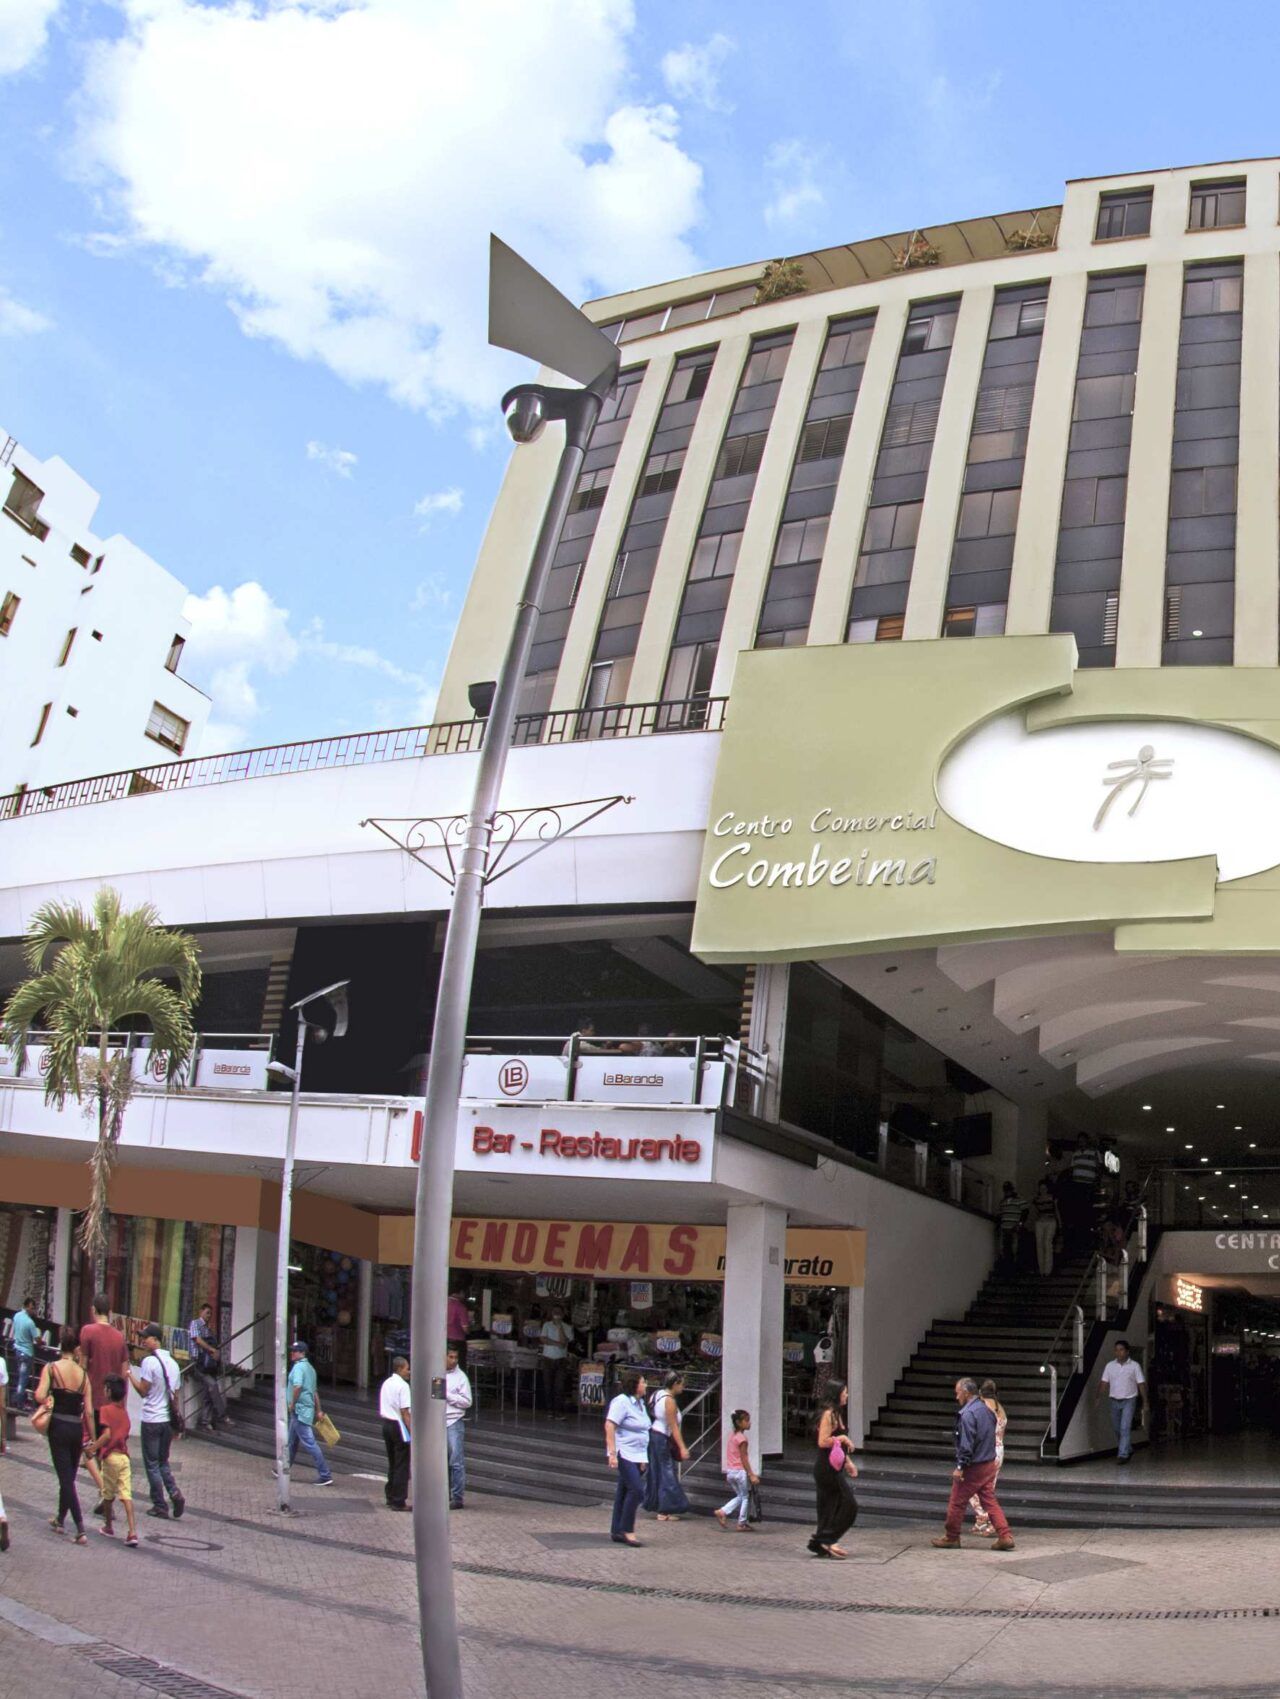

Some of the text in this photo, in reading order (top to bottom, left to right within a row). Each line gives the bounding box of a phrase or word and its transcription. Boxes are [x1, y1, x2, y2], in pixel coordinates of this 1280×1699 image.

[713, 807, 938, 838] Centro Comercial
[709, 841, 937, 889] Combeima
[472, 1126, 516, 1154] Bar
[538, 1129, 701, 1162] Restaurante
[452, 1220, 698, 1276] ENDEMAS
